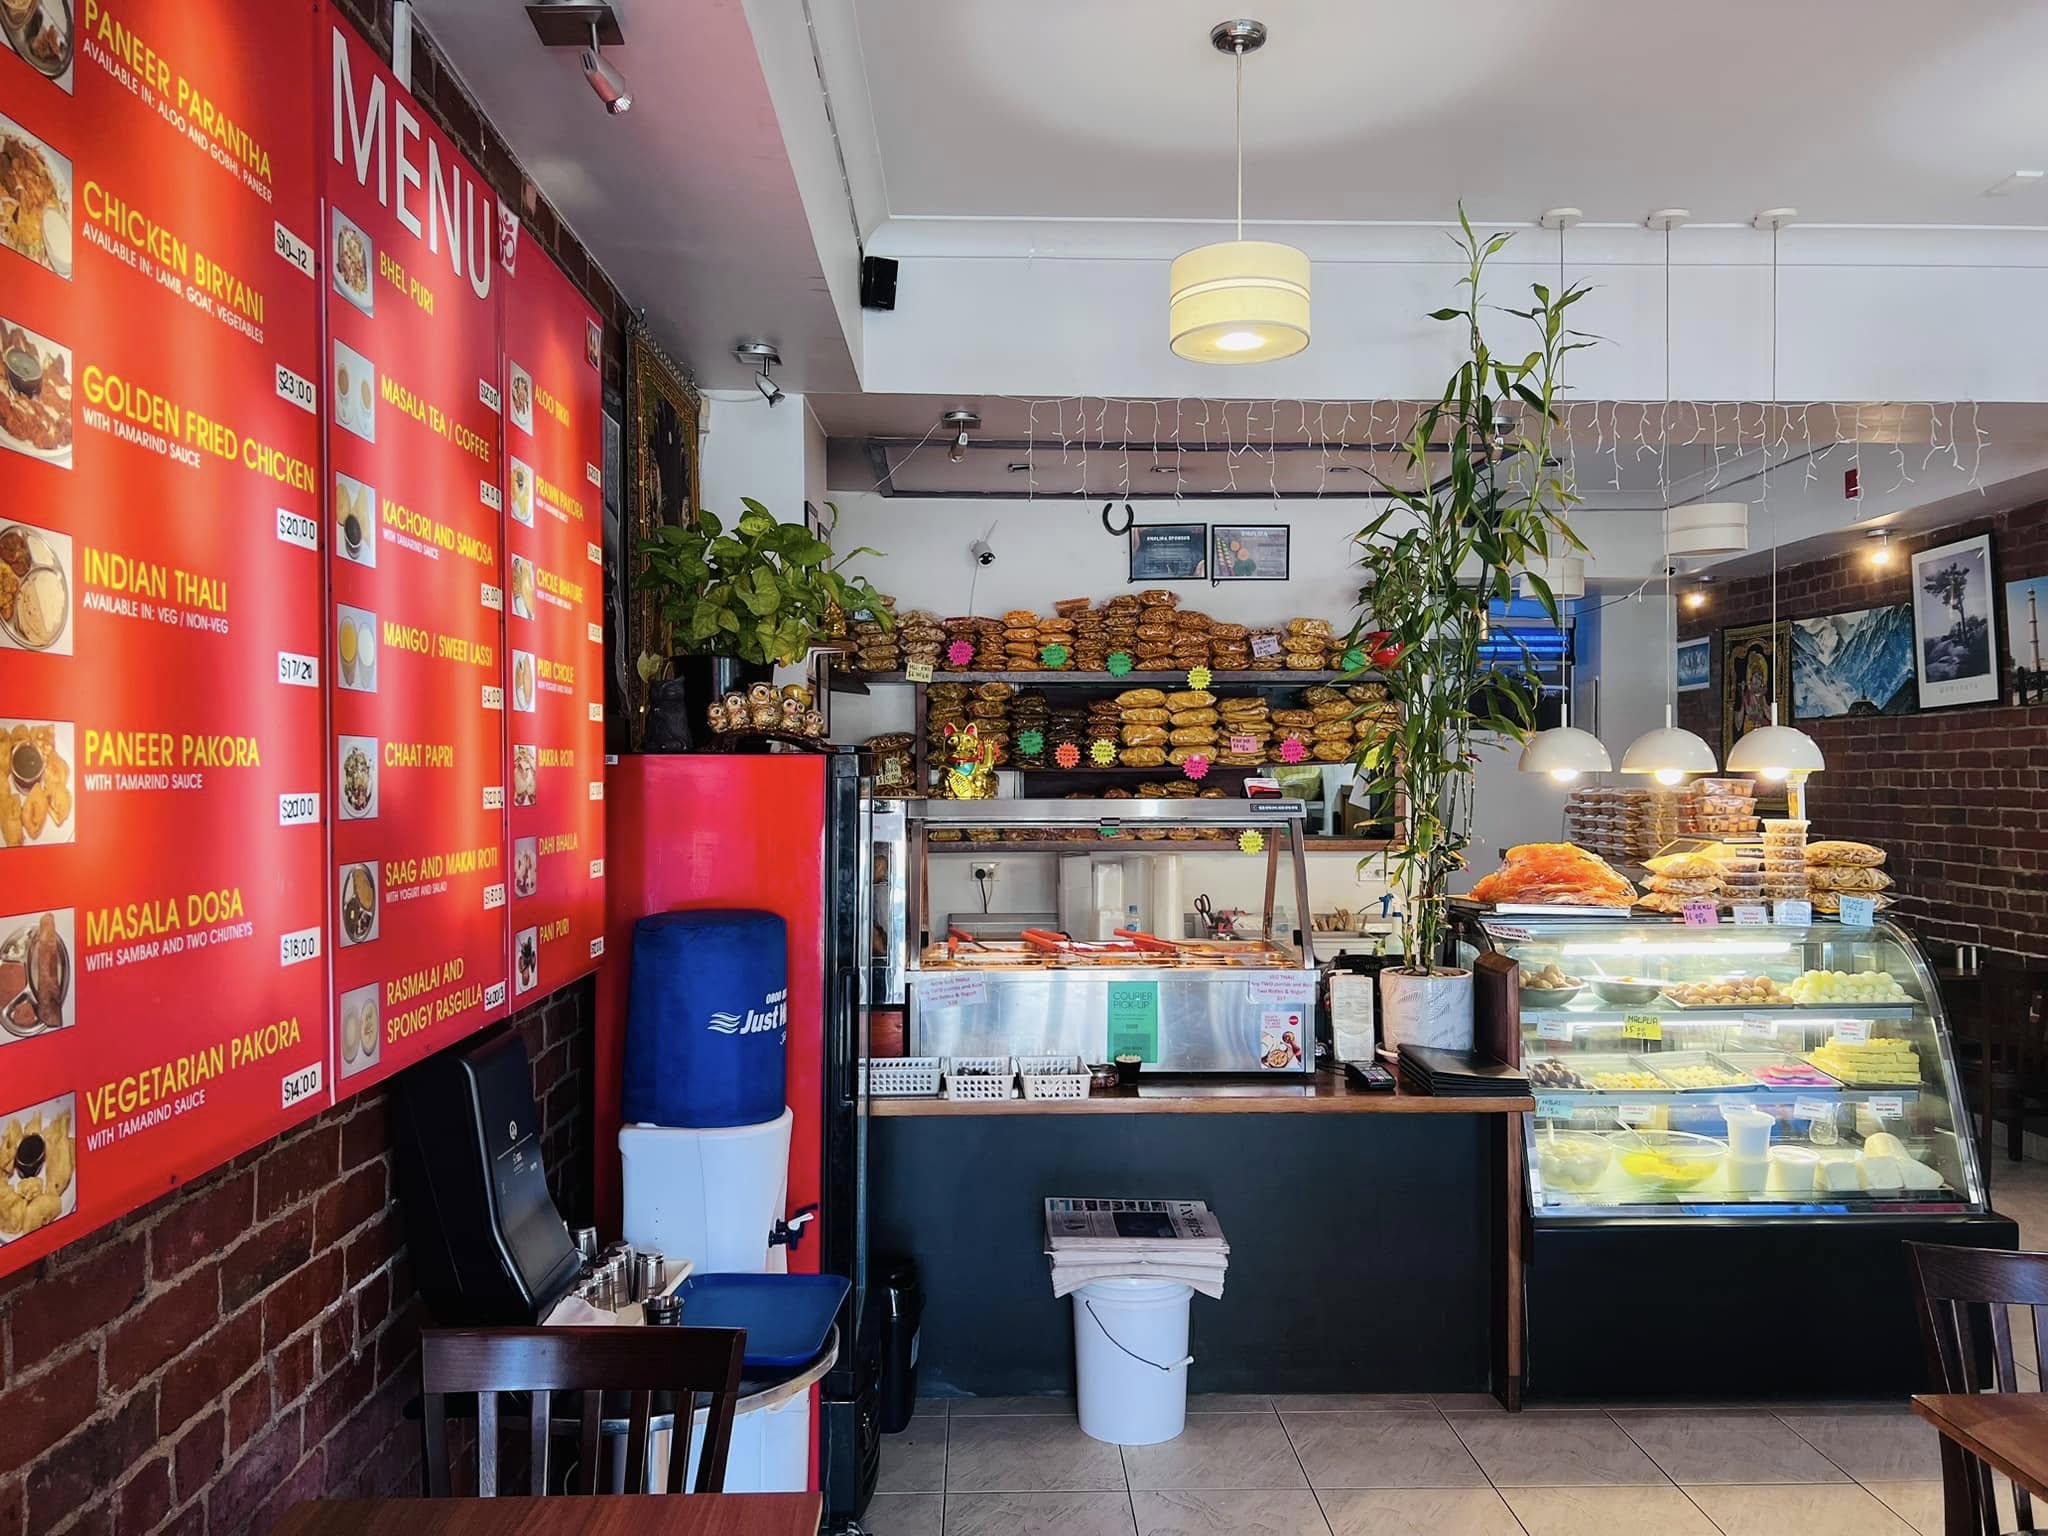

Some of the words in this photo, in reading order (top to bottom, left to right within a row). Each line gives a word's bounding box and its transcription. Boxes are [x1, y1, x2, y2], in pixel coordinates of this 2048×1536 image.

[83, 38, 138, 95] AVAILABLE
[141, 84, 155, 108] IN:
[157, 100, 186, 133] ALOO
[188, 125, 208, 151] AND
[243, 171, 272, 204] PANEER
[84, 0, 170, 98] PANEER
[177, 76, 272, 184] PARANTHA
[333, 25, 490, 300] MENU
[84, 181, 187, 275] CHICKEN
[195, 253, 264, 323] BIRYANI
[83, 222, 136, 267] AVAILABLE
[139, 257, 153, 277] IN:
[156, 266, 184, 298] LAMB,
[216, 306, 264, 344] VEGETABLES
[380, 250, 407, 295] BHEL
[411, 278, 433, 316] PURI
[381, 374, 427, 424] MASALA
[429, 405, 447, 437] TEA
[455, 424, 489, 462] COFFEE
[535, 384, 553, 414] ALOO
[83, 365, 179, 437] GOLDEN
[186, 411, 238, 460] FRIED
[243, 438, 315, 494] CHICKEN
[83, 407, 110, 432] WITH
[113, 419, 166, 455] TAMARIND
[170, 442, 200, 467] SAUCE
[383, 498, 432, 541] KACHORI
[434, 522, 455, 551] AND
[457, 535, 493, 567] SAMOSA
[83, 547, 166, 600] INDIAN
[174, 569, 228, 612] THALI
[536, 567, 558, 593] CHOLE
[83, 592, 138, 617] AVAILABLE
[141, 602, 154, 620] IN:
[158, 606, 178, 625] VEG
[186, 612, 229, 634] NON-VEG
[383, 621, 429, 654] MANGO
[438, 635, 468, 664] SWEET
[470, 642, 493, 667] LASSI
[537, 658, 552, 679] PURI
[553, 663, 575, 684] CHOLE
[84, 730, 173, 766] PANEER
[182, 735, 260, 767] PAKORA
[385, 743, 422, 768] CHAAT
[425, 745, 454, 768] PAPRI
[84, 774, 112, 790] WITH
[115, 773, 169, 790] TAMARIND
[172, 773, 203, 790] SAUCE
[385, 859, 417, 886] SAAG
[420, 856, 443, 880] AND
[477, 847, 498, 869] ROTI
[86, 897, 181, 946] MASALA
[188, 887, 245, 918] DOSA
[539, 922, 555, 944] PANI
[86, 950, 114, 972] WITH
[116, 939, 159, 966] SAMBAR
[162, 935, 184, 956] AND
[186, 930, 208, 950] TWO
[210, 922, 253, 946] CHUTNEYS
[387, 965, 440, 1007] RASMALAI
[443, 957, 464, 986] AND
[1112, 991, 1153, 1001] COURIER
[387, 1002, 433, 1043] SPONGY
[436, 983, 482, 1022] RASGULLA
[740, 1004, 779, 1036] Just
[86, 1043, 225, 1125] VEGETARIAN
[231, 1017, 301, 1070] PAKORA
[87, 1128, 115, 1151] WITH
[118, 1104, 171, 1141] TAMARIND
[174, 1089, 206, 1116] SAUCE
